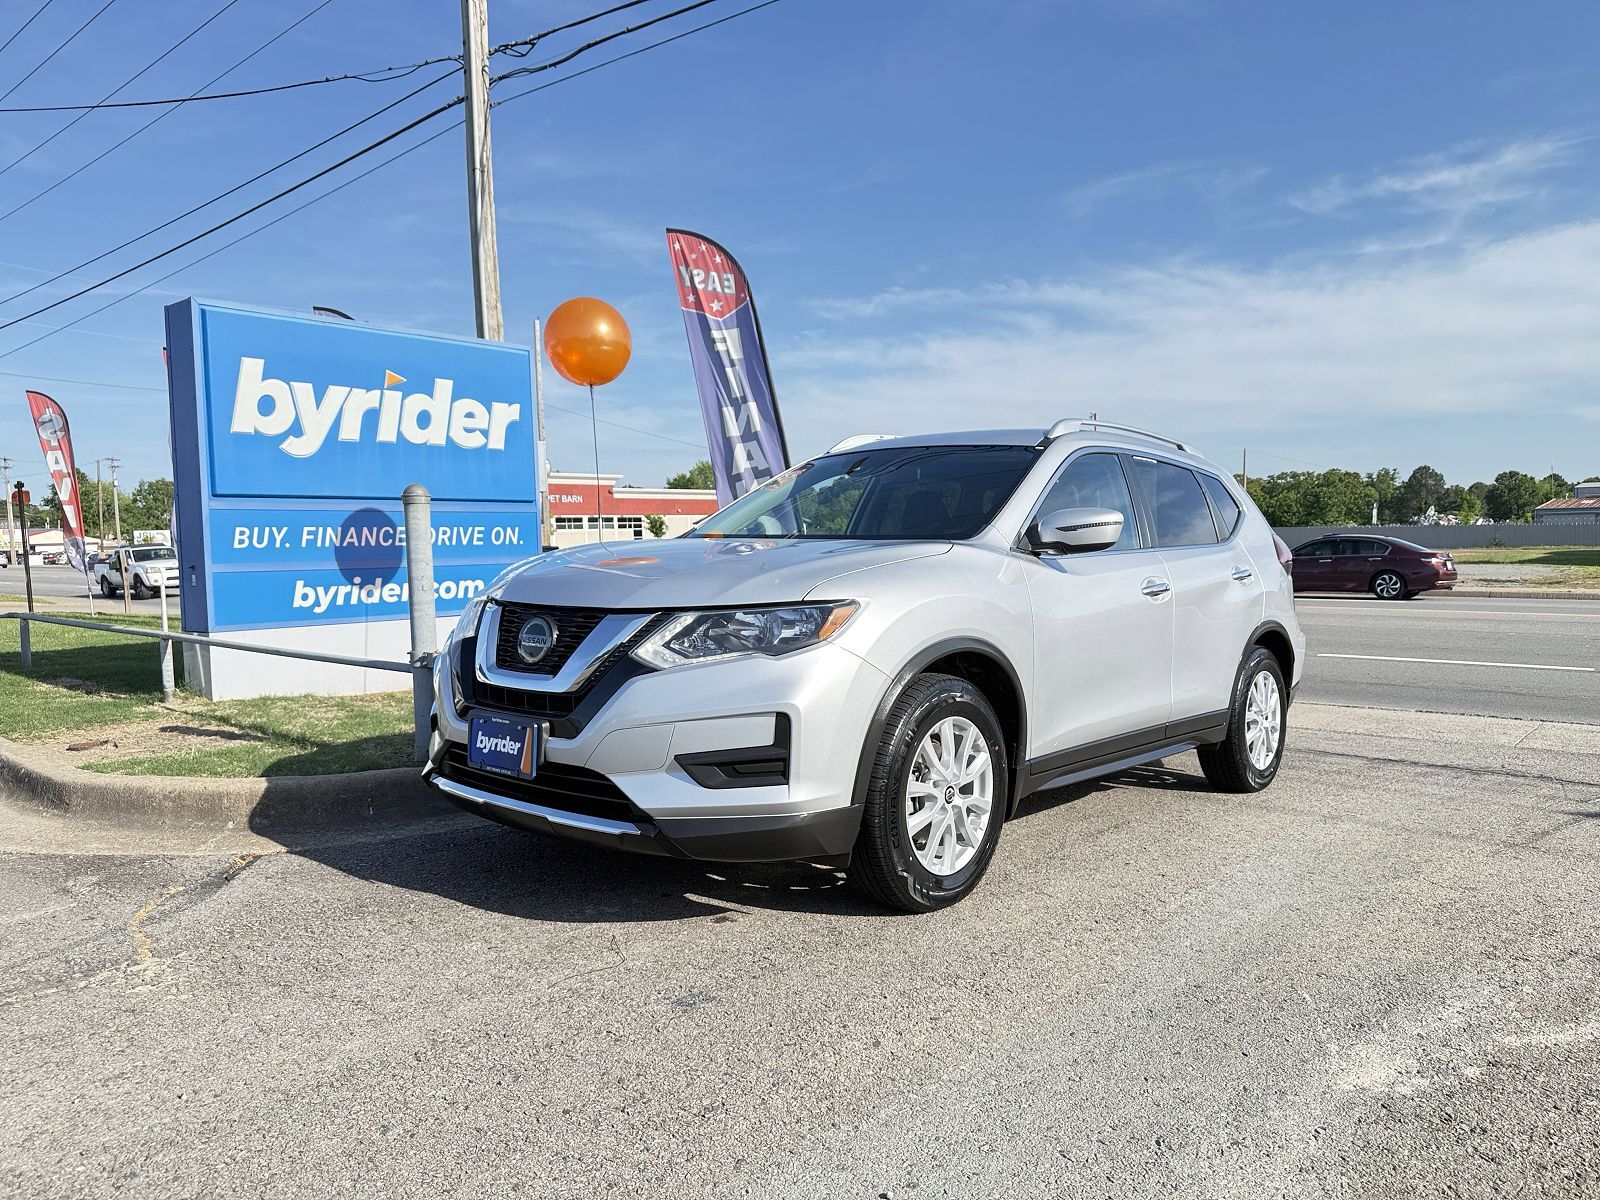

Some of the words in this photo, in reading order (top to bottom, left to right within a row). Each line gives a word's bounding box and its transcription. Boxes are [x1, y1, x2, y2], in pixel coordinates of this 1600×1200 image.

[229, 356, 521, 458] byrider
[561, 494, 583, 503] BARN
[233, 526, 290, 549] BUY.
[491, 526, 524, 545] ON.
[293, 576, 485, 614] byriderom
[520, 636, 548, 646] NISSAN
[476, 731, 521, 755] byrider
